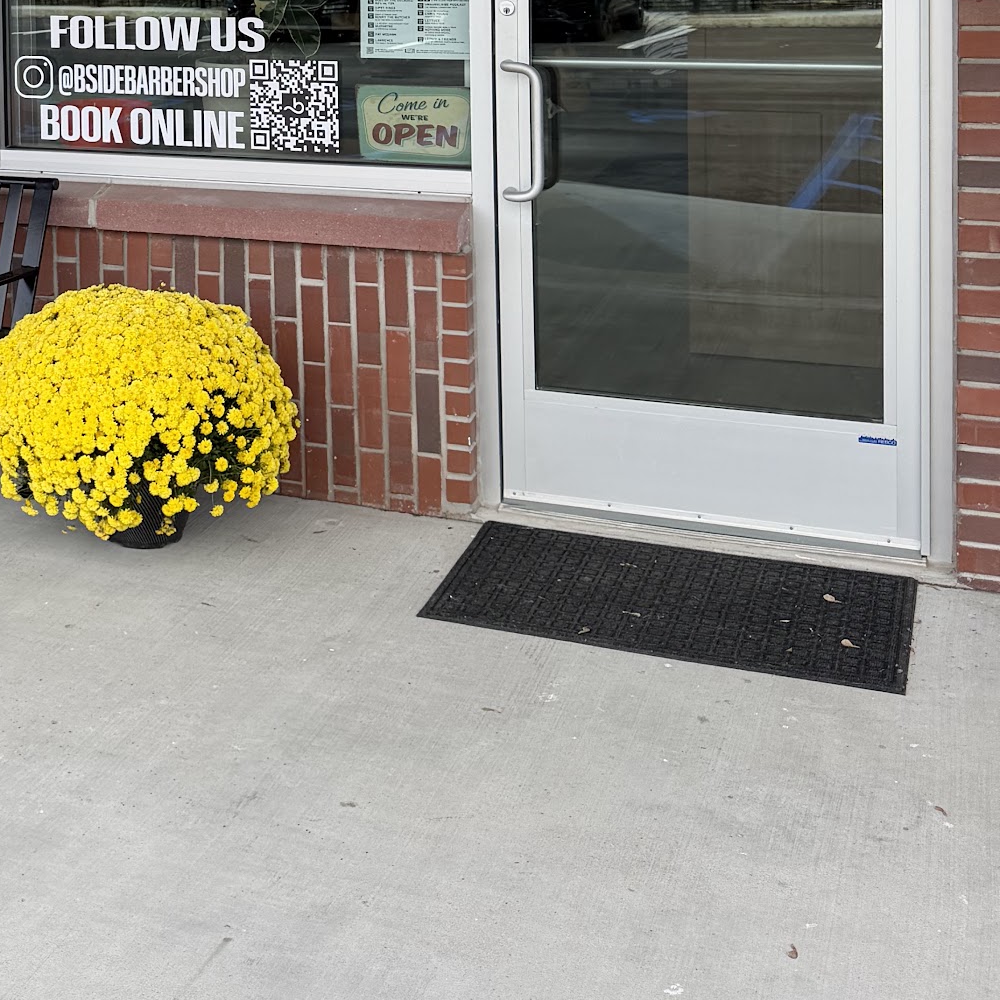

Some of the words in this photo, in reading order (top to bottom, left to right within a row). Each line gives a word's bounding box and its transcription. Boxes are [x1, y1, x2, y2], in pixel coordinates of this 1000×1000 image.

[50, 15, 200, 51] FOLLOW
[210, 17, 266, 52] US
[58, 63, 246, 98] @BSIDEBARBERSHOP
[378, 92, 427, 114] Come
[433, 98, 449, 109] in
[40, 104, 123, 144] BOOK
[130, 107, 245, 149] ONLINE
[372, 122, 459, 148] OPEN
